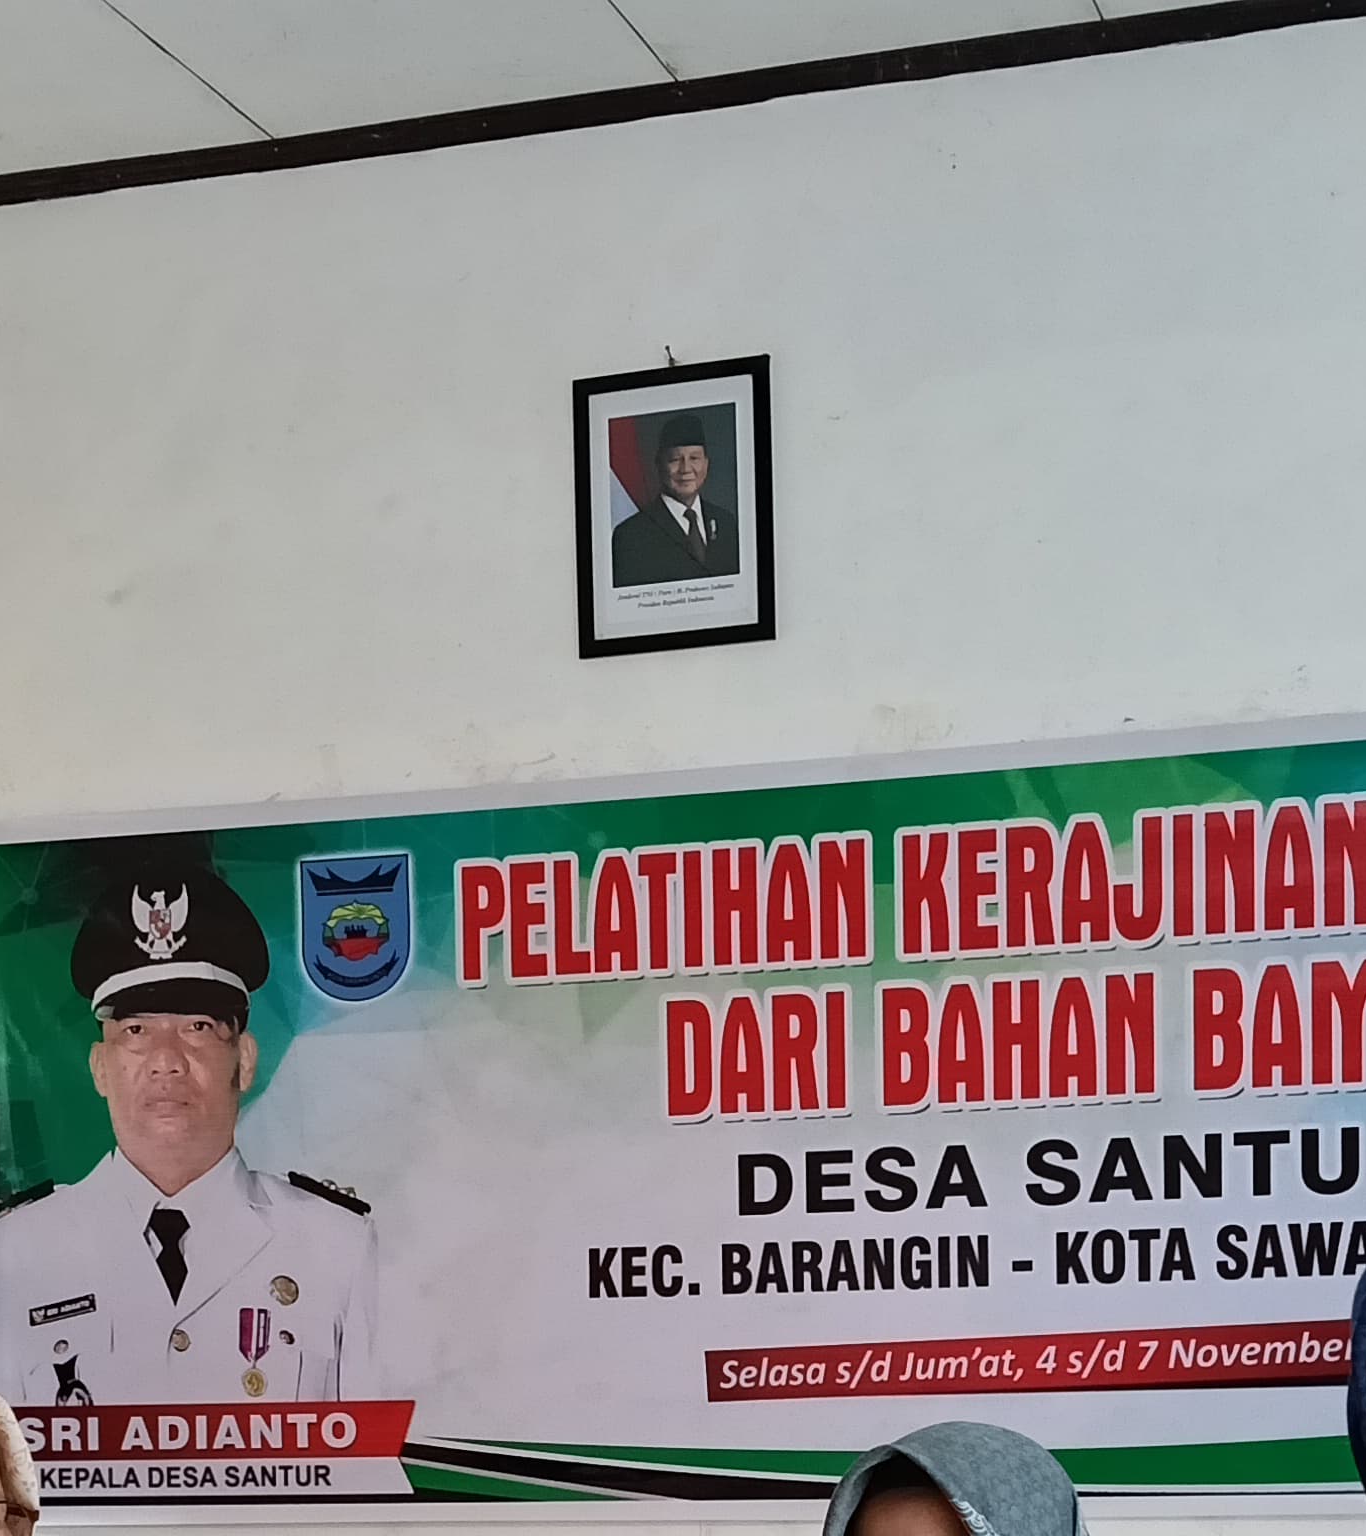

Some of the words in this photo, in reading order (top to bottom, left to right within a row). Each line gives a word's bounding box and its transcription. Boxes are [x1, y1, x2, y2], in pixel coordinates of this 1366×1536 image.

[458, 835, 871, 984] PELATIHAN
[664, 989, 847, 1118] DARI
[880, 970, 1156, 1108] BAHAN
[737, 1144, 989, 1216] DESA
[587, 1244, 701, 1299] KEC.
[721, 1234, 990, 1295] BARANGIN
[1055, 1227, 1197, 1285] KOTA
[719, 1356, 826, 1390] Selasa
[834, 1350, 893, 1390] s/d
[1035, 1344, 1057, 1375] 4
[1066, 1340, 1126, 1381] s/d
[1136, 1340, 1160, 1371] 7
[17, 1415, 100, 1453] SRI
[120, 1411, 358, 1451] ADIANTO
[40, 1466, 141, 1490] KEPALA
[147, 1465, 218, 1488] DESA
[224, 1464, 332, 1488] SANTUR
